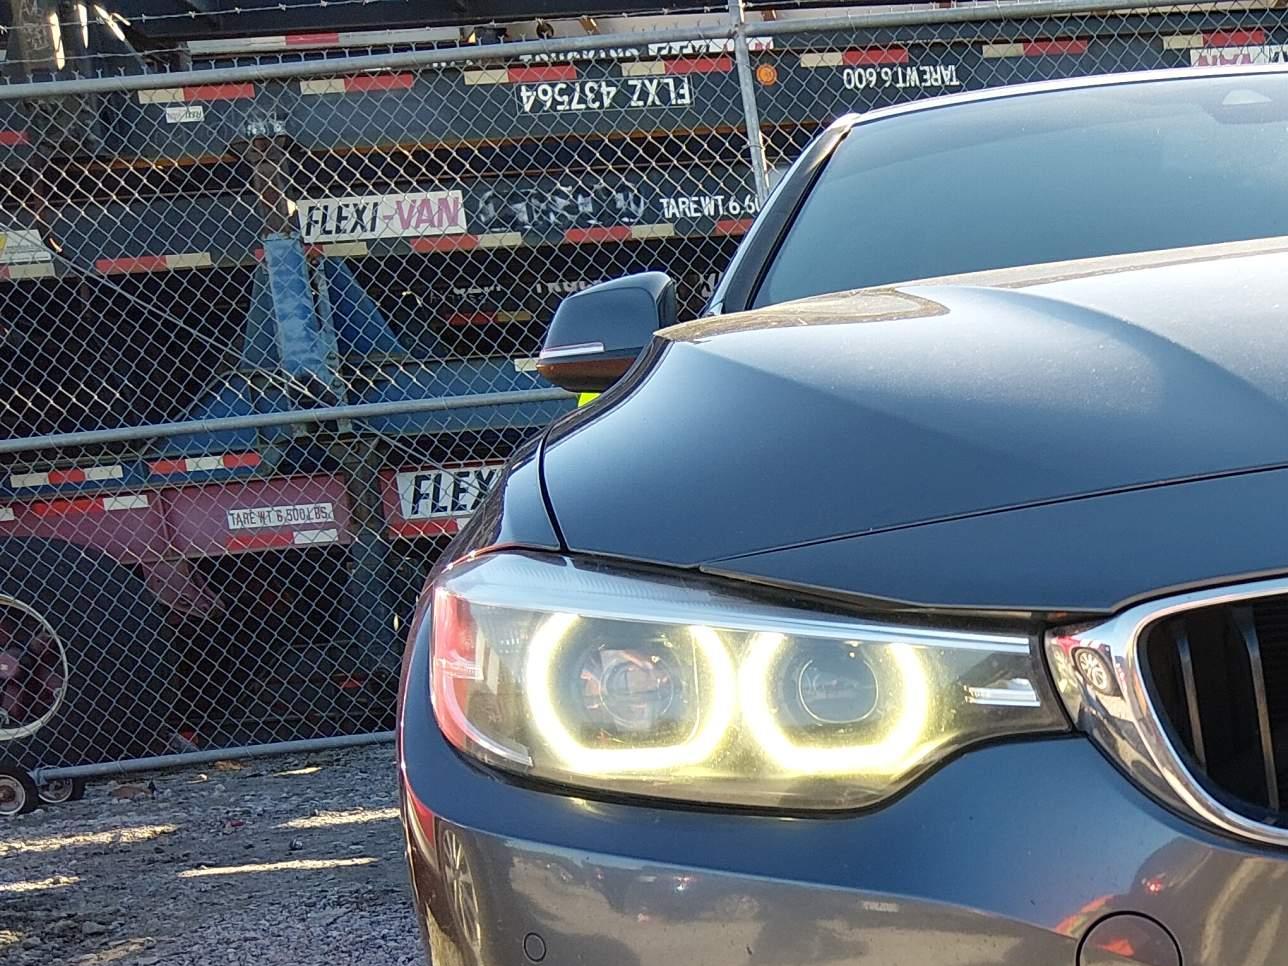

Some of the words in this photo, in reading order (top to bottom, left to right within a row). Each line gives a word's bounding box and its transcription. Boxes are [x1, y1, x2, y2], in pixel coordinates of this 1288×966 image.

[520, 80, 617, 112] 437564
[627, 76, 692, 107] FLXZ
[305, 196, 460, 237] FLEXI-VAN
[229, 511, 256, 527] TARE
